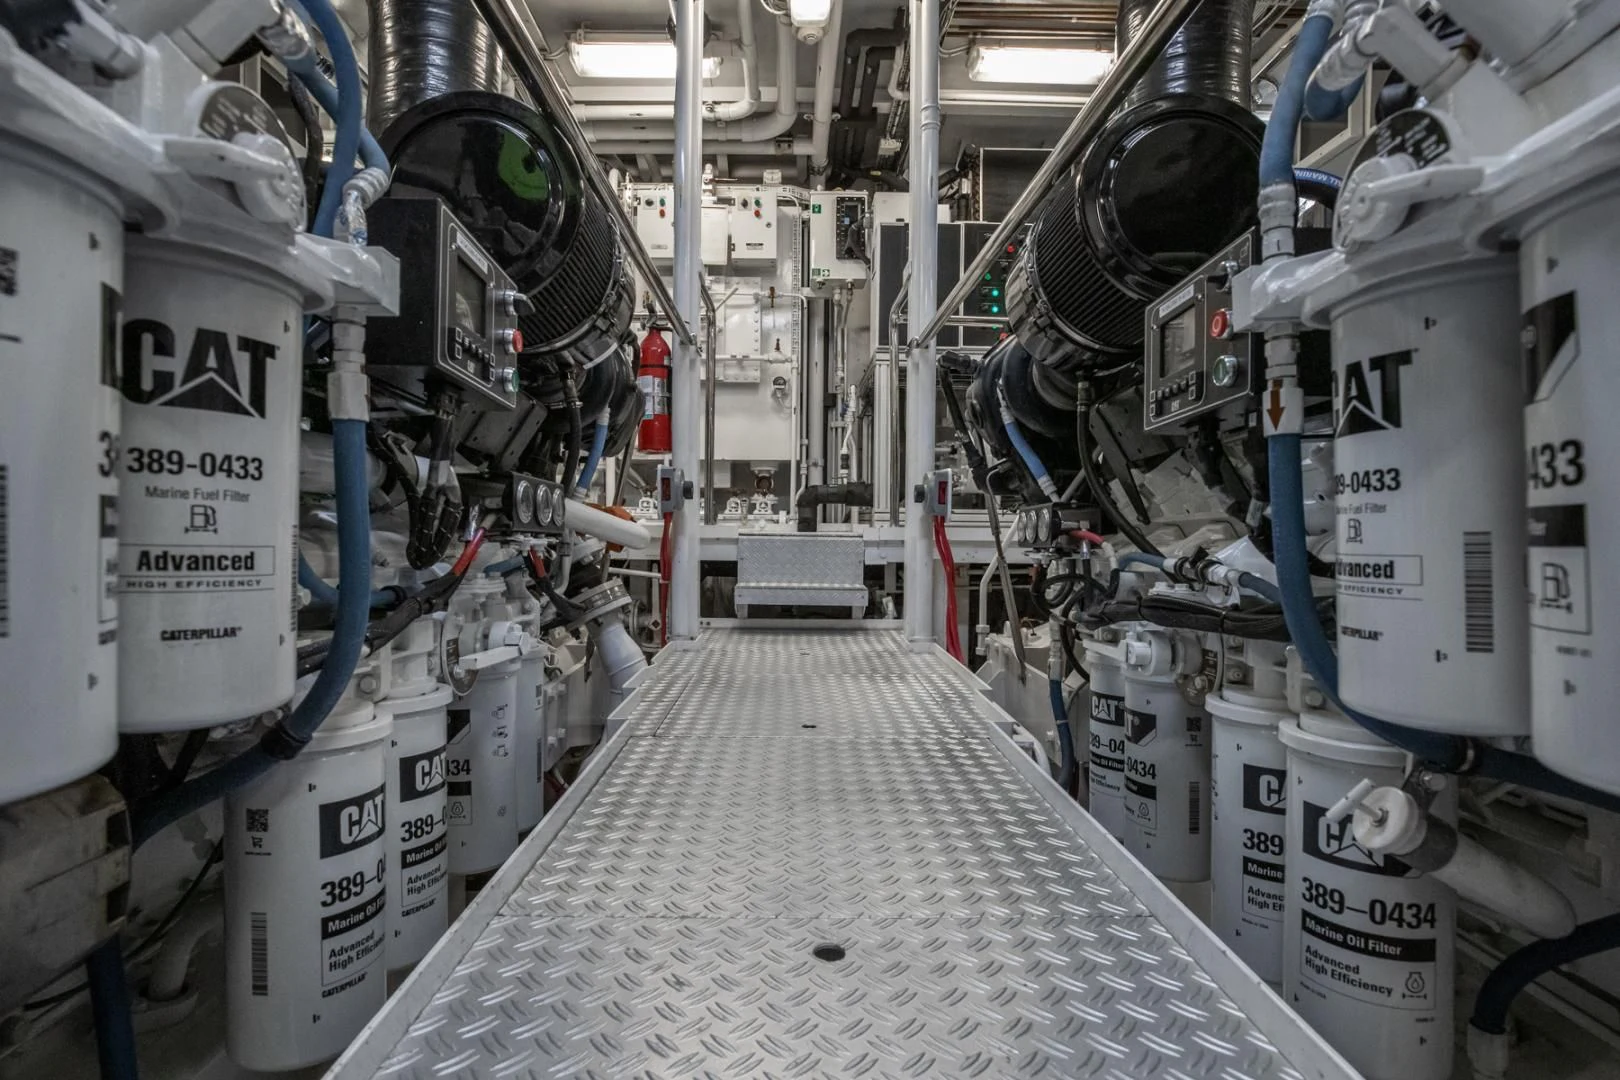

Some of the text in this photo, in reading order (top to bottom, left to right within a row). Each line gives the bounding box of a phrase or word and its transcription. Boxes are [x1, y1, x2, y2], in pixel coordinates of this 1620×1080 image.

[122, 318, 278, 419] CAT
[127, 447, 263, 481] 389-0433
[145, 486, 251, 502] Marine Fuel Filter
[137, 550, 255, 572] Advanced
[127, 579, 262, 589] HIGH EFFICIENCY
[160, 627, 242, 641] CATERPILLAR
[1091, 695, 1118, 722] CAT
[340, 792, 385, 845] CAT
[1243, 828, 1285, 857] 389
[406, 848, 434, 865] Marine
[407, 864, 441, 886] Advanced
[1247, 862, 1283, 879] Marine
[407, 883, 426, 896] High
[1247, 896, 1270, 911] High
[1301, 877, 1437, 930] 389-0434
[327, 911, 366, 933] Marine
[329, 929, 375, 961] Advanced
[1305, 917, 1403, 956] Marine Oil Filter
[329, 955, 354, 973] High
[1305, 944, 1360, 976] Advanced
[1305, 957, 1328, 977] High
[1330, 968, 1393, 998] Efficiency
